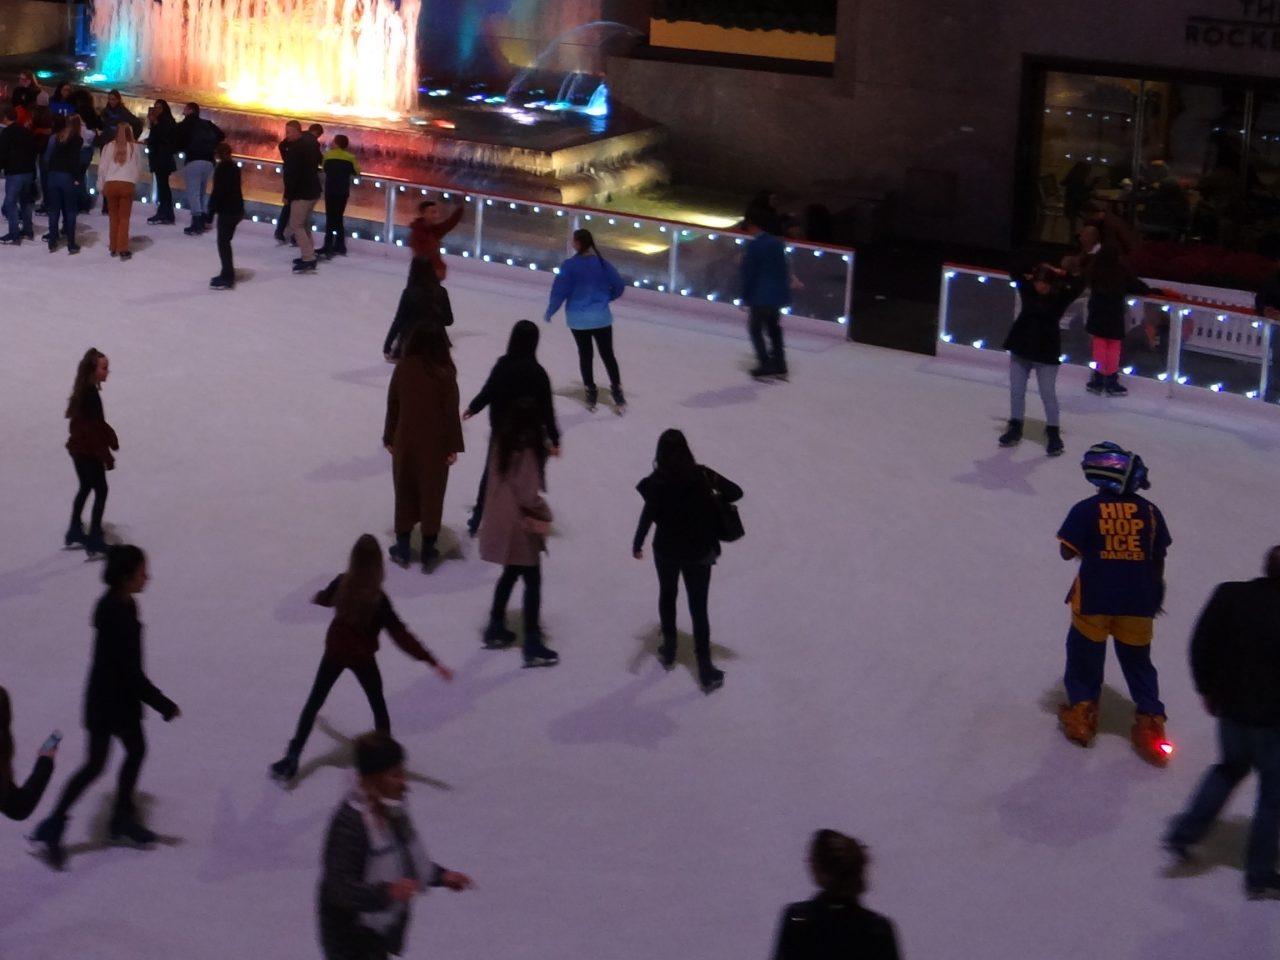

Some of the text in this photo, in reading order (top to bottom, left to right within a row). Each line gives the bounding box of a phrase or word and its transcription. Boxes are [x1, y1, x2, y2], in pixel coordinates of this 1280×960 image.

[1099, 502, 1138, 519] HIP
[1099, 519, 1145, 536] HOP
[1104, 535, 1142, 552] ICE
